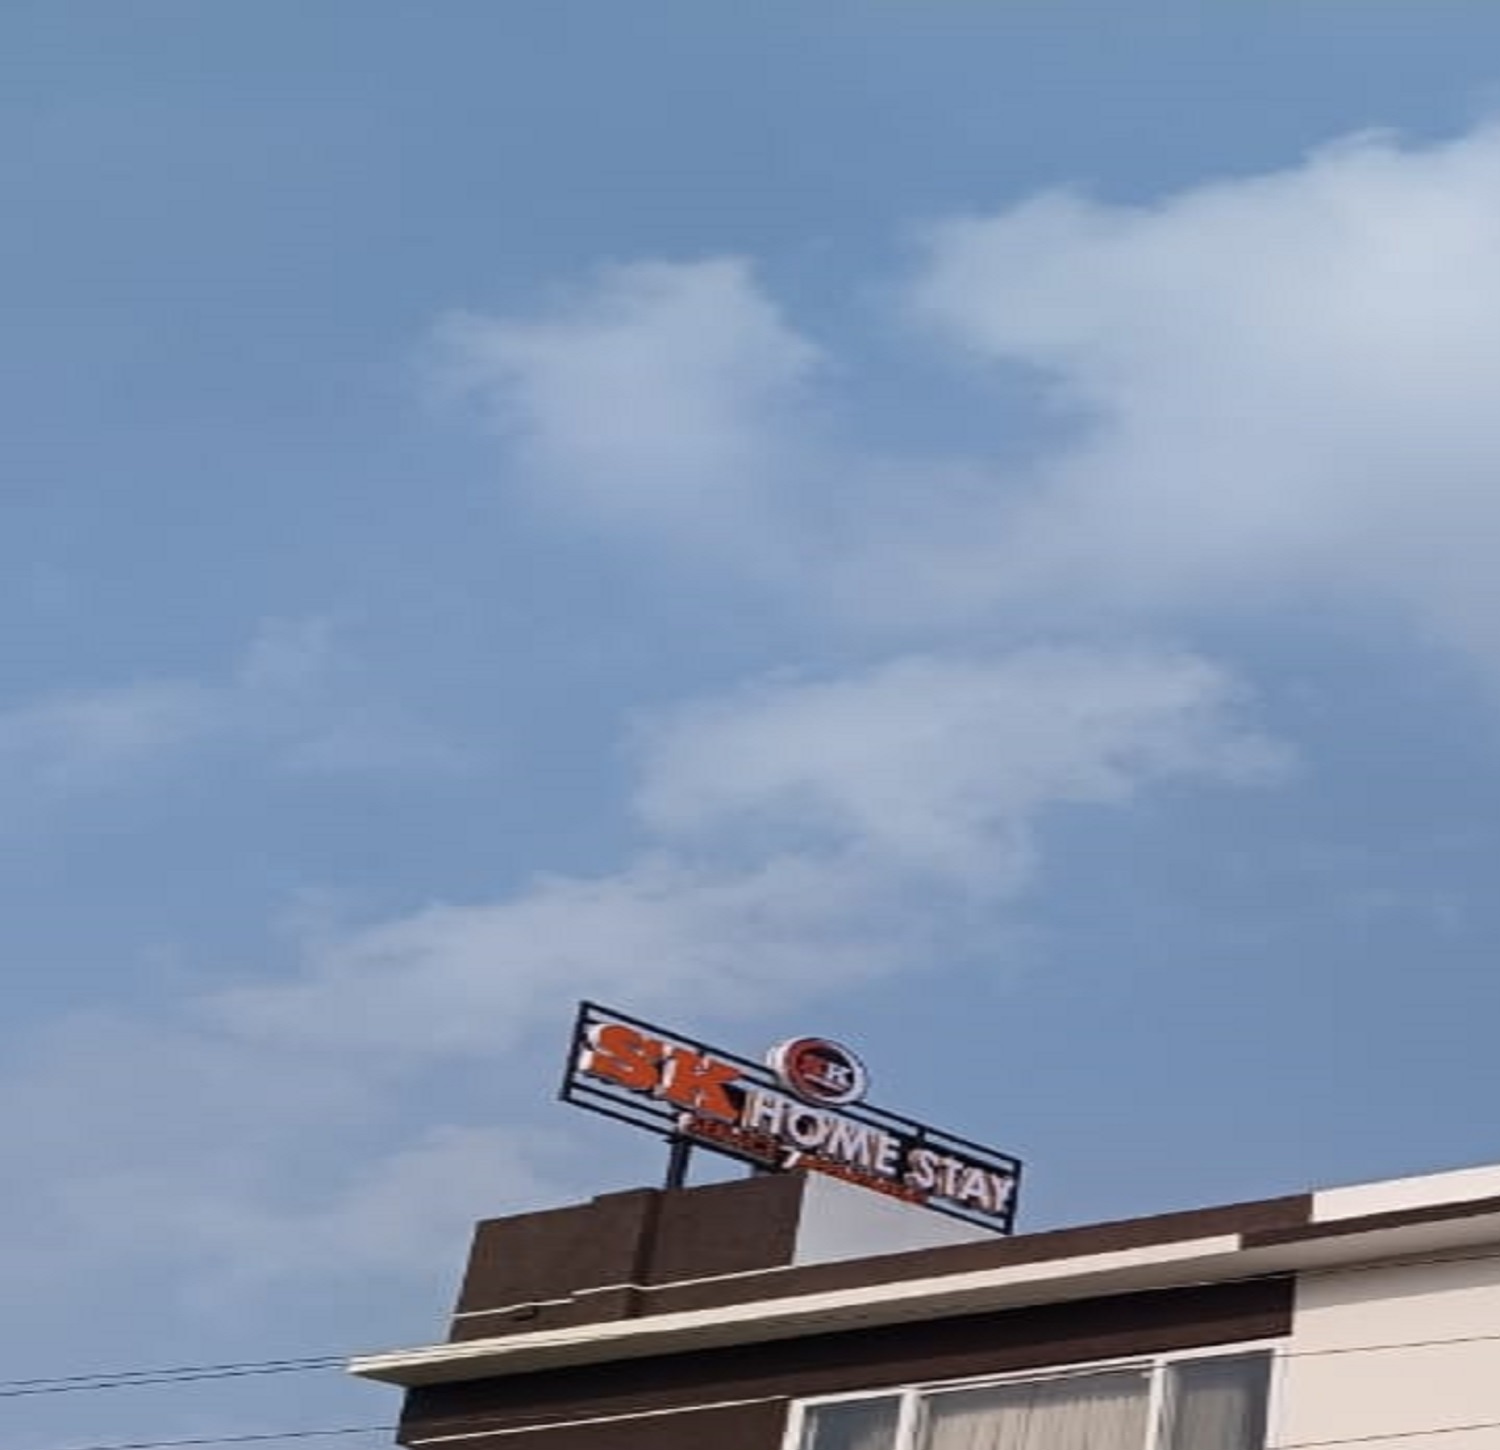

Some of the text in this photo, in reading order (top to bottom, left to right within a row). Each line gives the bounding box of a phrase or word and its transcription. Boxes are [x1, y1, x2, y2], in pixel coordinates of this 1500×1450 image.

[578, 1022, 743, 1121] SK
[740, 1090, 900, 1176] HOME
[905, 1147, 1014, 1213] STAY
